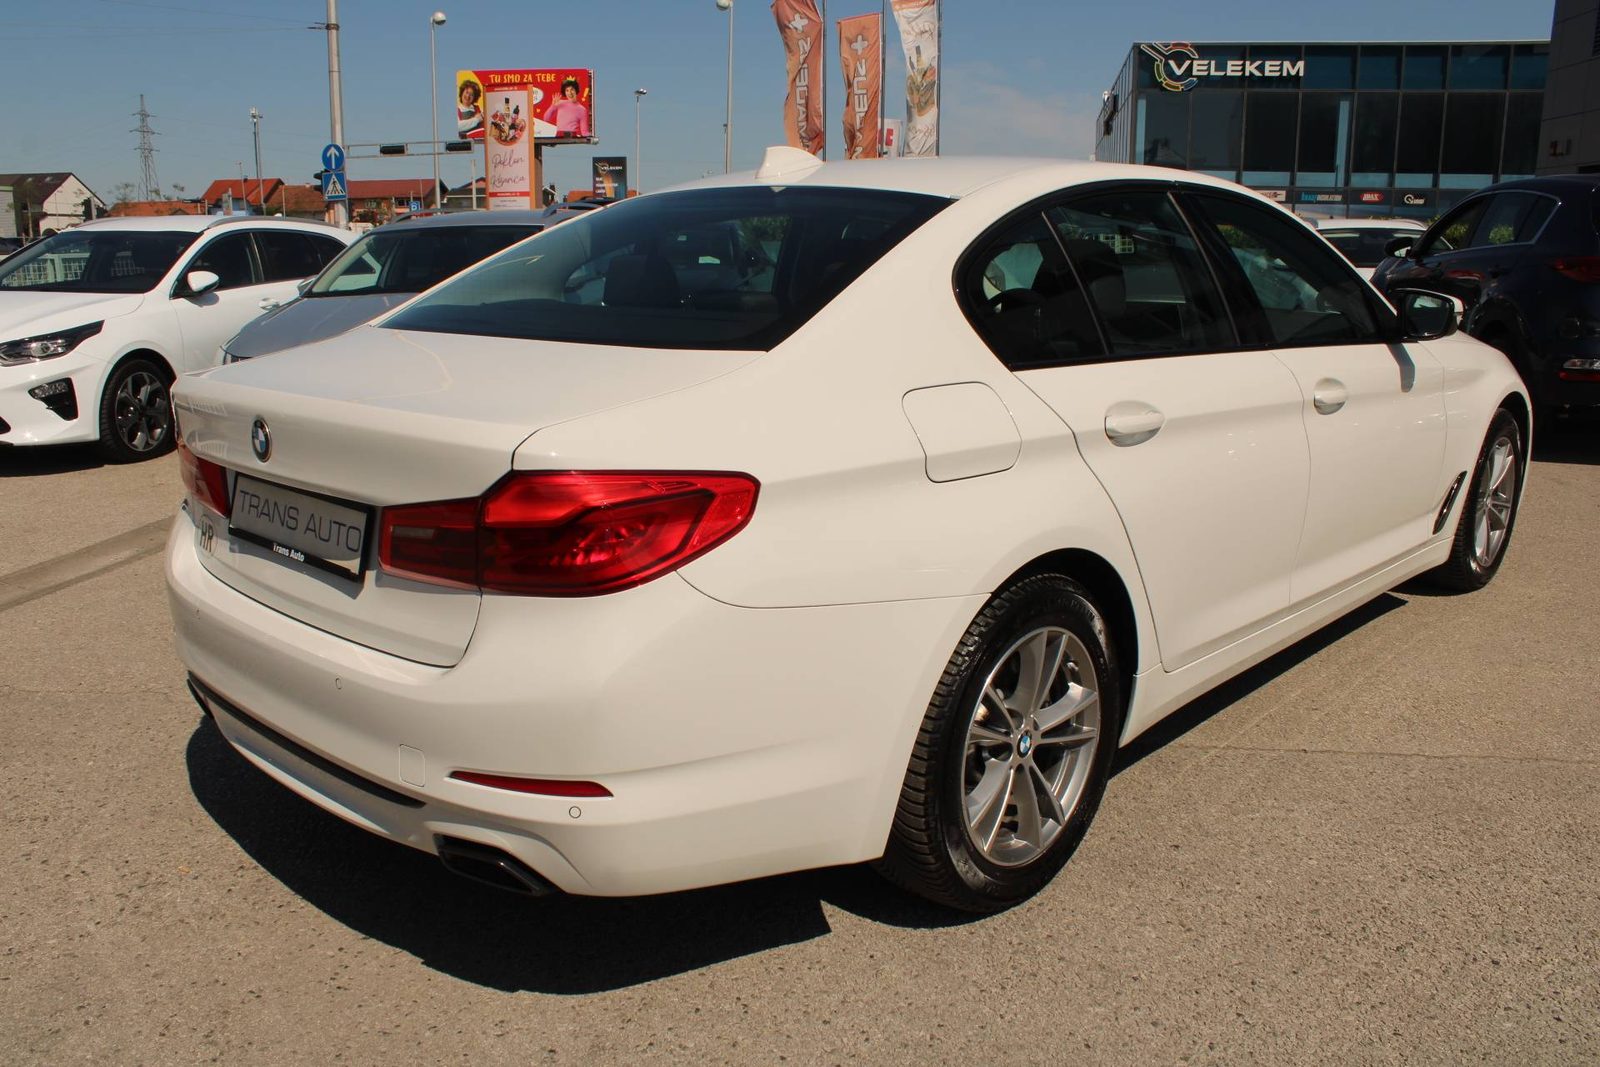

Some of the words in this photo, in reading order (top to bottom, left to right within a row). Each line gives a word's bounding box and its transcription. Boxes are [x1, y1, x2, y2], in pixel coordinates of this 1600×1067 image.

[1168, 59, 1305, 77] VELEKEM
[489, 74, 501, 84] TU
[503, 74, 520, 83] SMO
[523, 74, 533, 83] ZA
[536, 73, 556, 82] TEBE
[239, 489, 299, 531] TRANS
[304, 513, 362, 553] AUTO
[200, 520, 214, 552] HR
[273, 542, 289, 556] Trans
[290, 549, 305, 562] Auto
